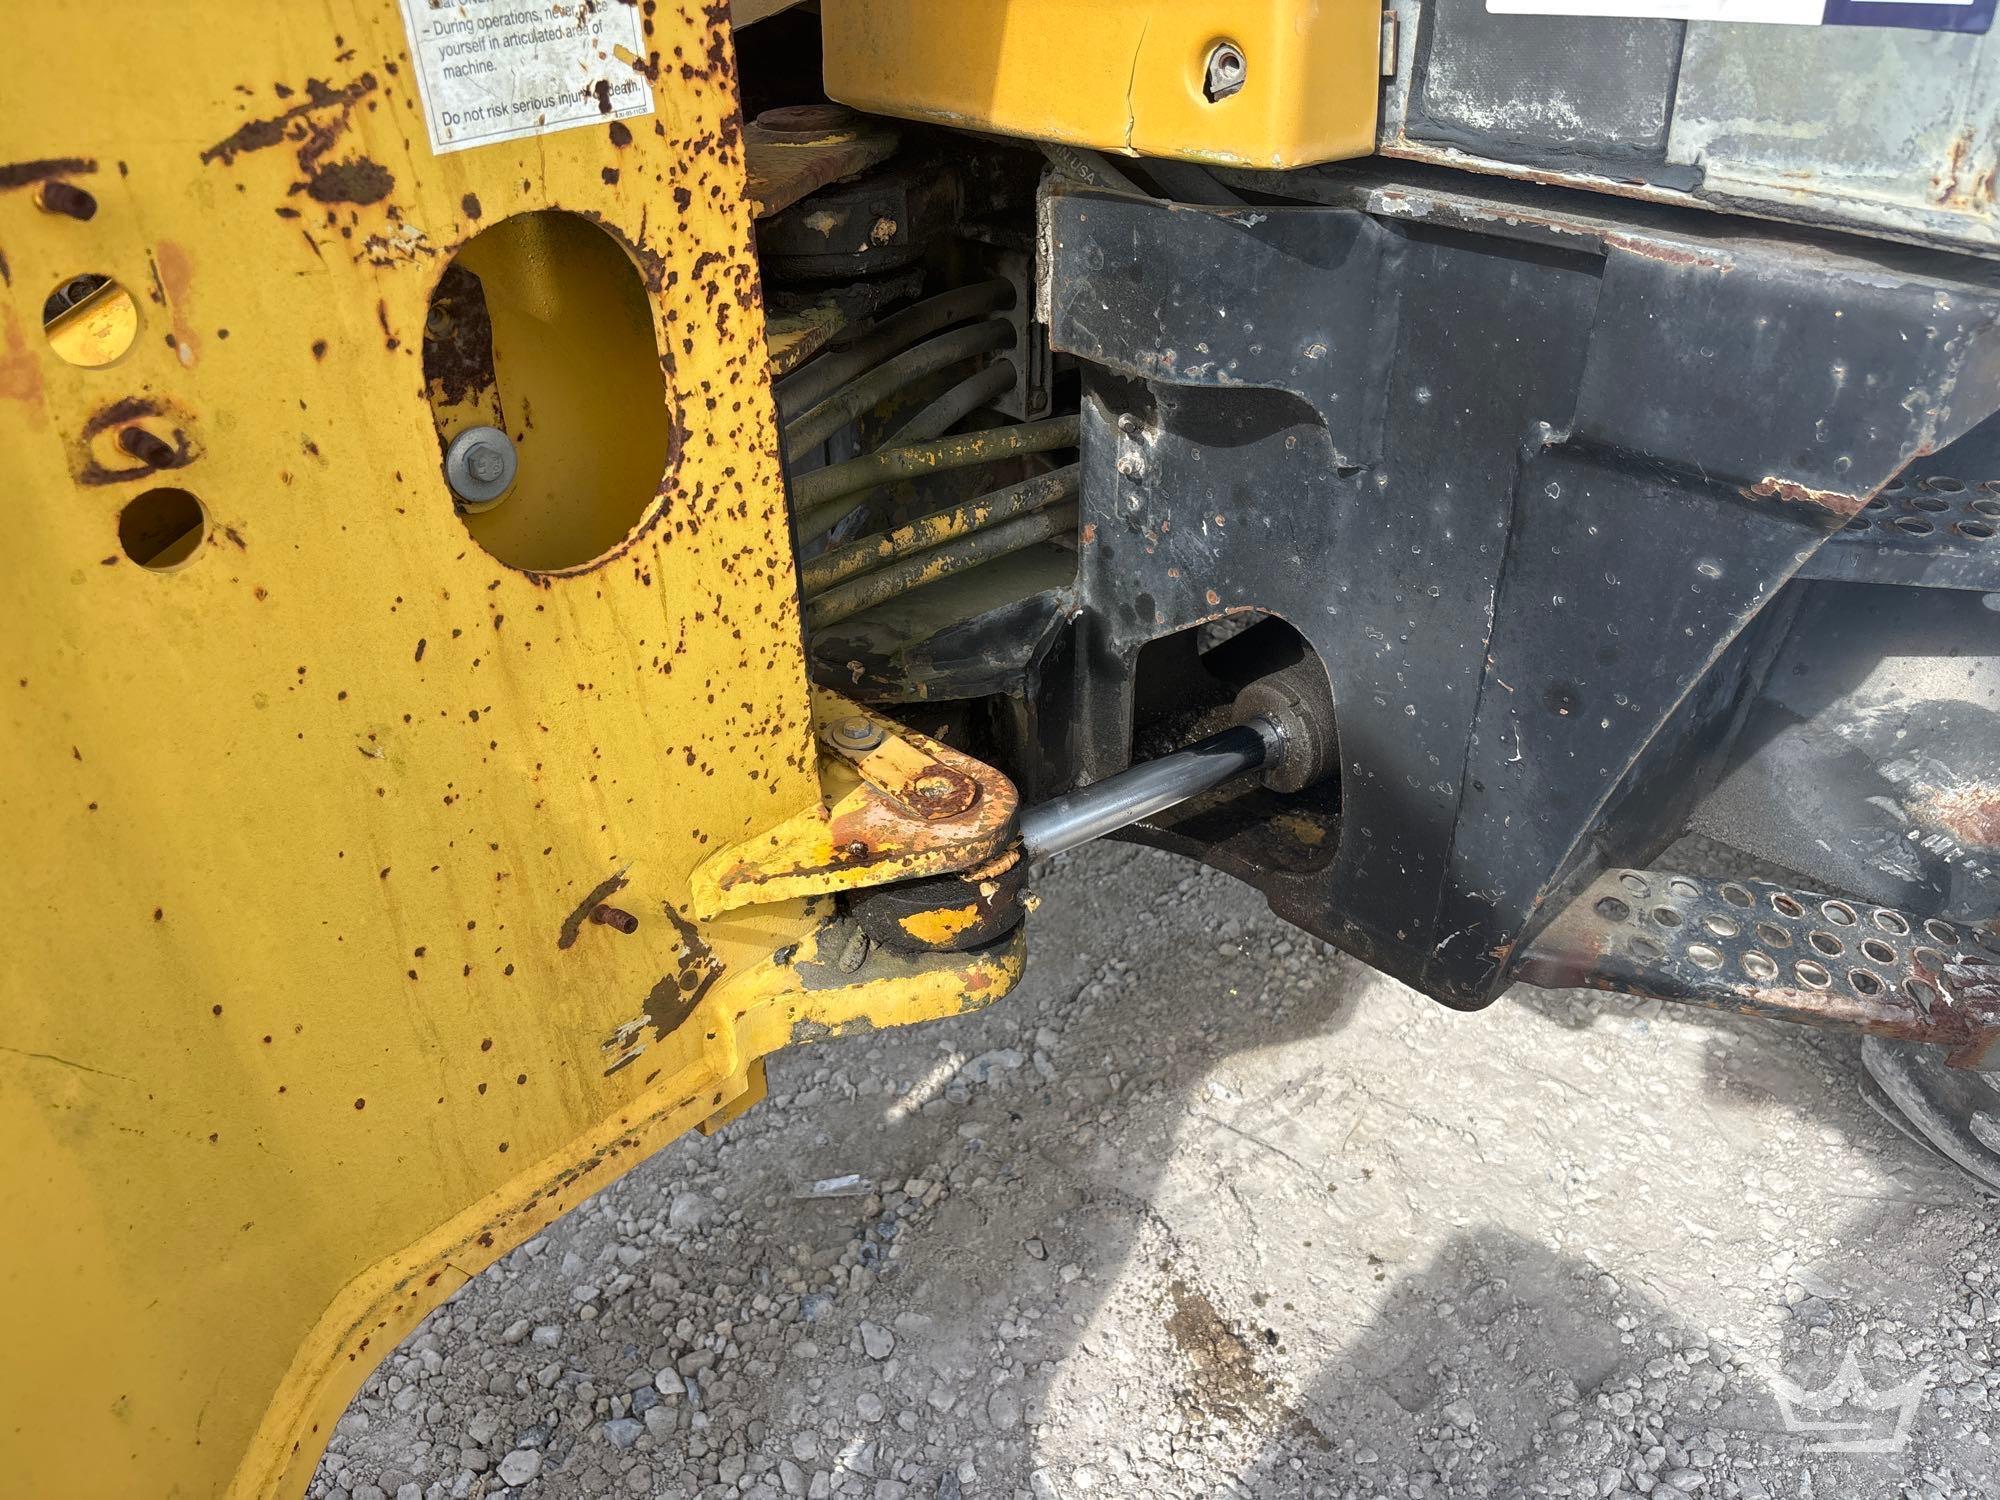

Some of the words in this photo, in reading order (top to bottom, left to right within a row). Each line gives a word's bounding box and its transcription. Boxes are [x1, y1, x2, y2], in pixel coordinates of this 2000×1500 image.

[433, 17, 474, 36] During
[477, 9, 543, 32] operations,
[438, 35, 487, 62] yourself
[488, 35, 500, 50] in
[503, 25, 563, 48] articulated
[566, 24, 590, 38] area
[592, 19, 603, 34] of
[442, 58, 498, 81] machine.
[441, 111, 460, 126] Do
[464, 106, 485, 123] not
[487, 102, 510, 119] risk
[512, 95, 556, 114] serious
